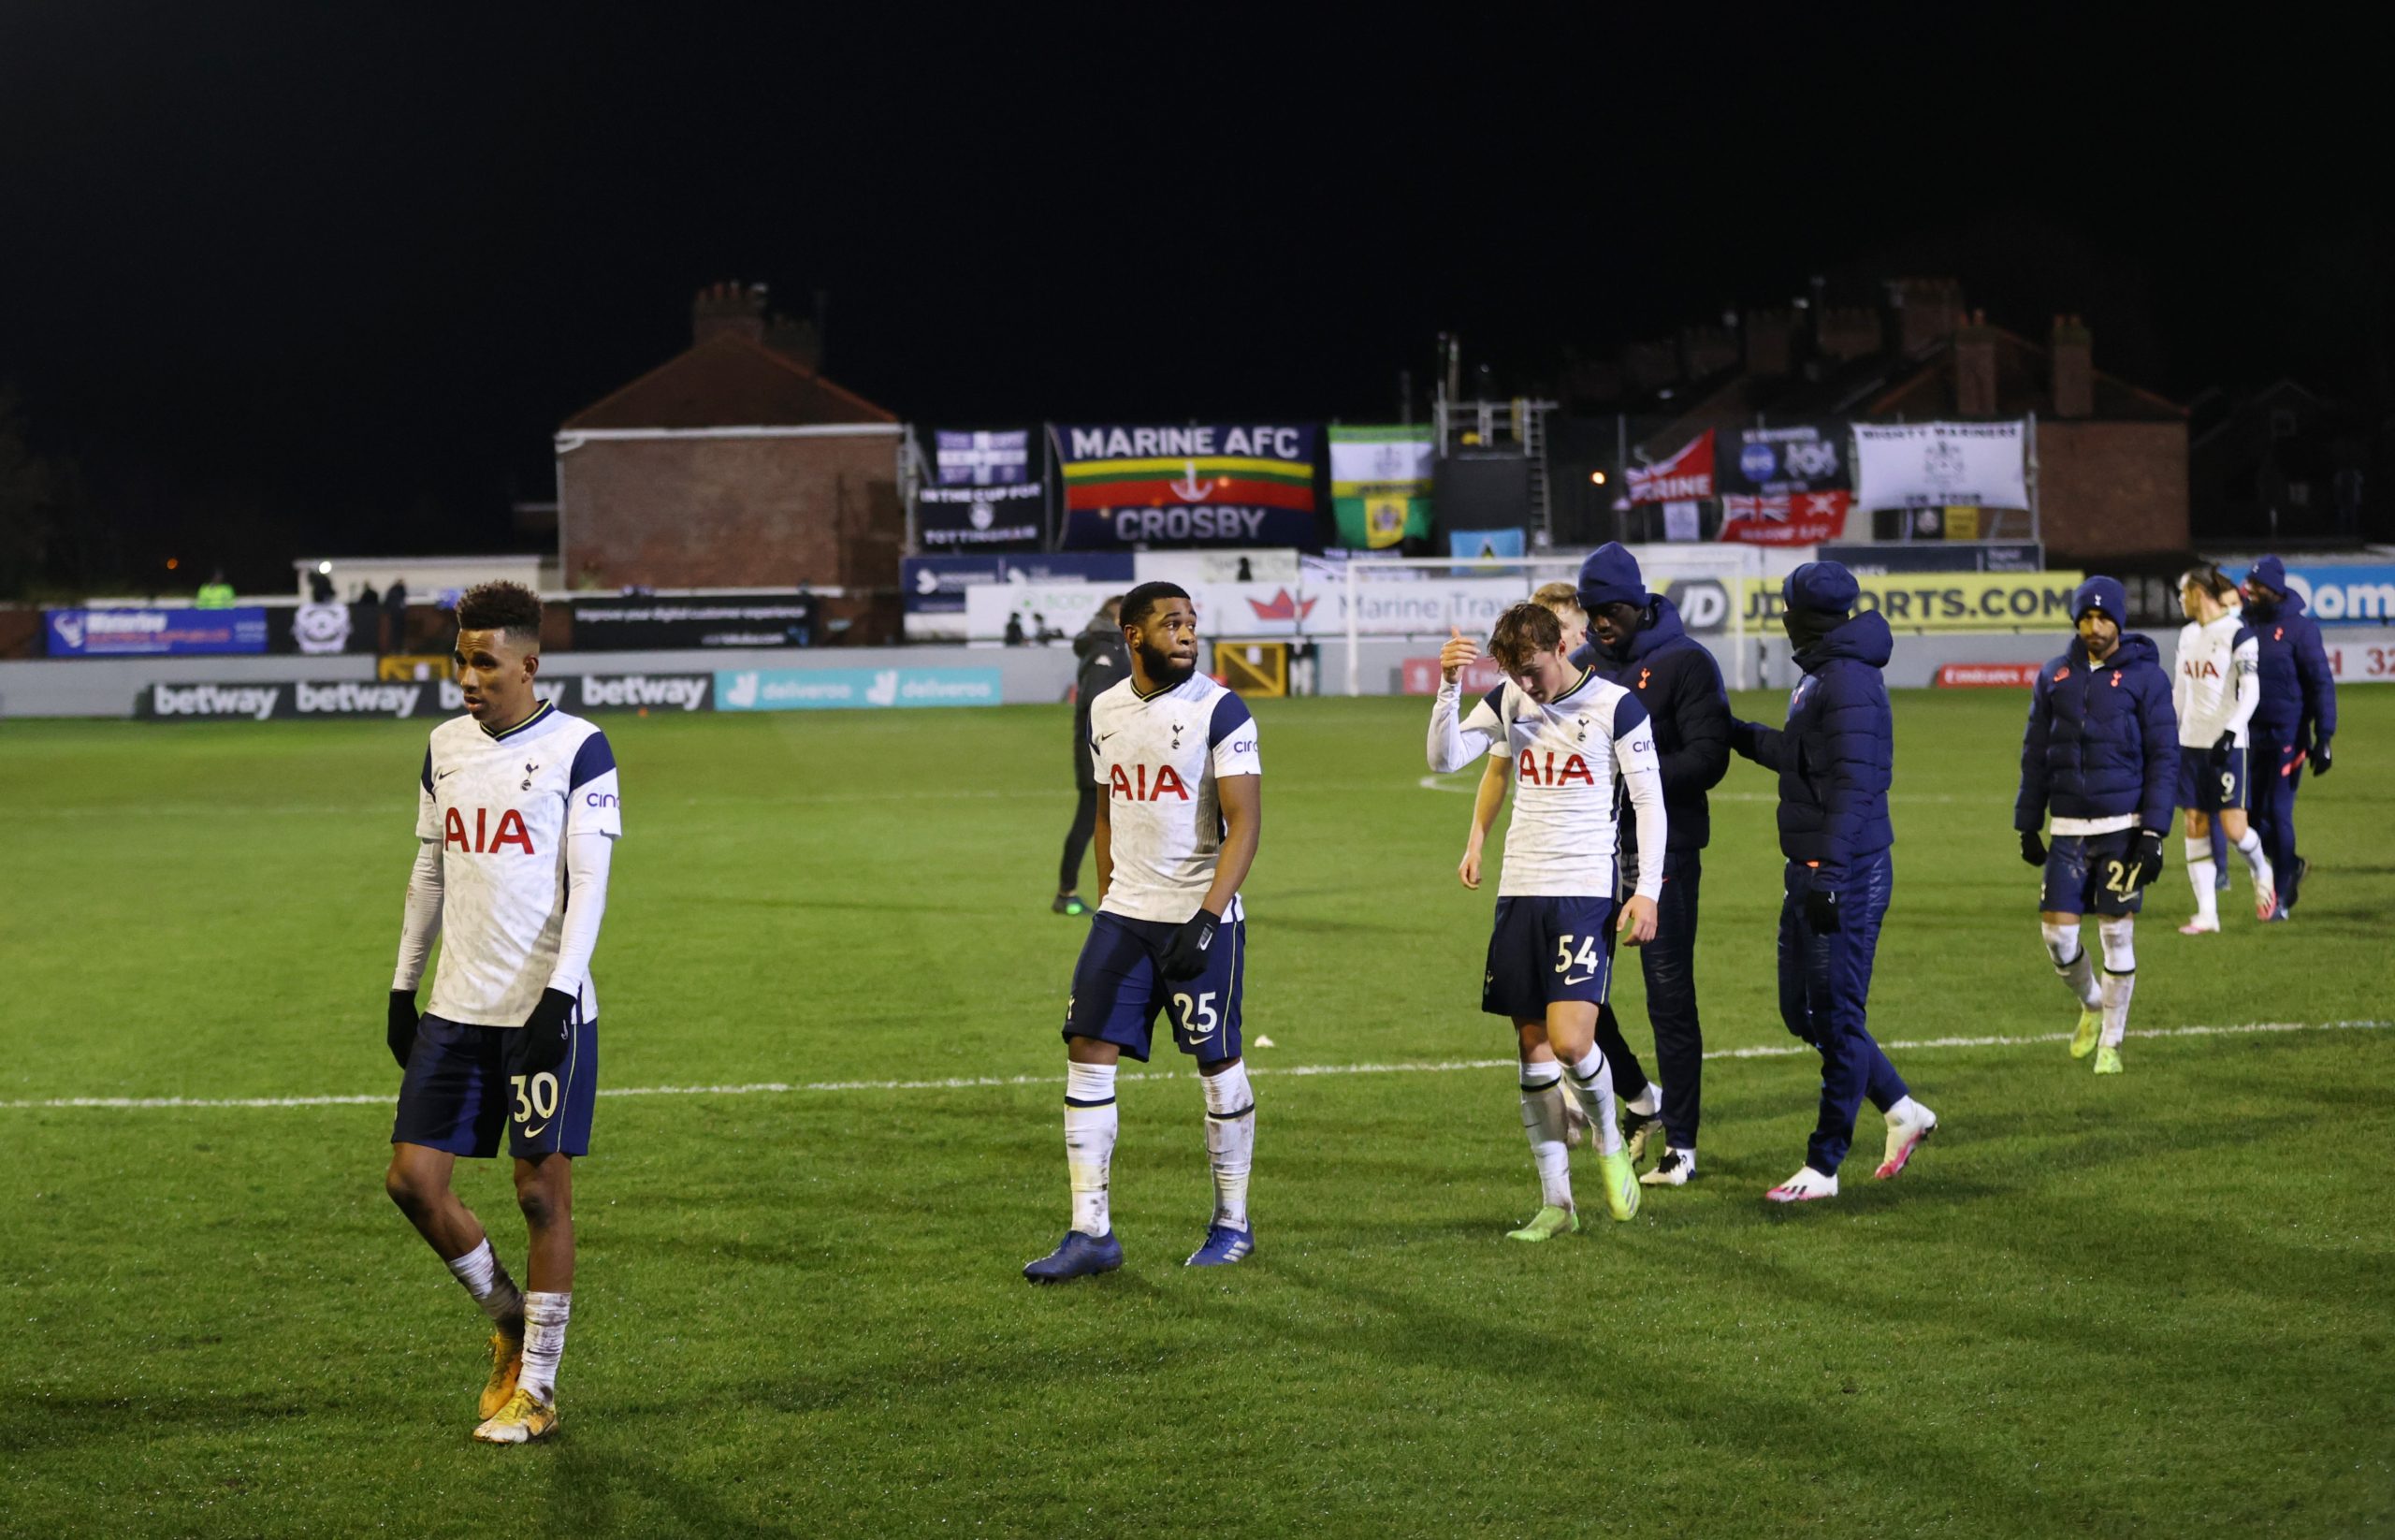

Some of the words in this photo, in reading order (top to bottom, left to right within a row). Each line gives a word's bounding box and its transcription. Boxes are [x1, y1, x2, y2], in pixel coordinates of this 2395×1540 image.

[1071, 427, 1214, 458] MARINE
[1224, 427, 1299, 458] AFC
[973, 486, 1007, 502] CUP
[1116, 505, 1265, 540] CROSBY
[1339, 593, 1439, 619] Marine
[1744, 588, 2074, 618] JDORTS.COM
[2185, 660, 2219, 678] AIA
[153, 684, 279, 720] betway
[296, 682, 420, 719] betway
[582, 676, 708, 711] betway
[1110, 763, 1189, 801] AIA
[1519, 748, 1594, 786] AIA
[2221, 772, 2235, 794] 9
[445, 807, 535, 854] AIA
[1555, 935, 1598, 974] 54
[1173, 991, 1217, 1033] 25
[511, 1071, 559, 1123] 30
